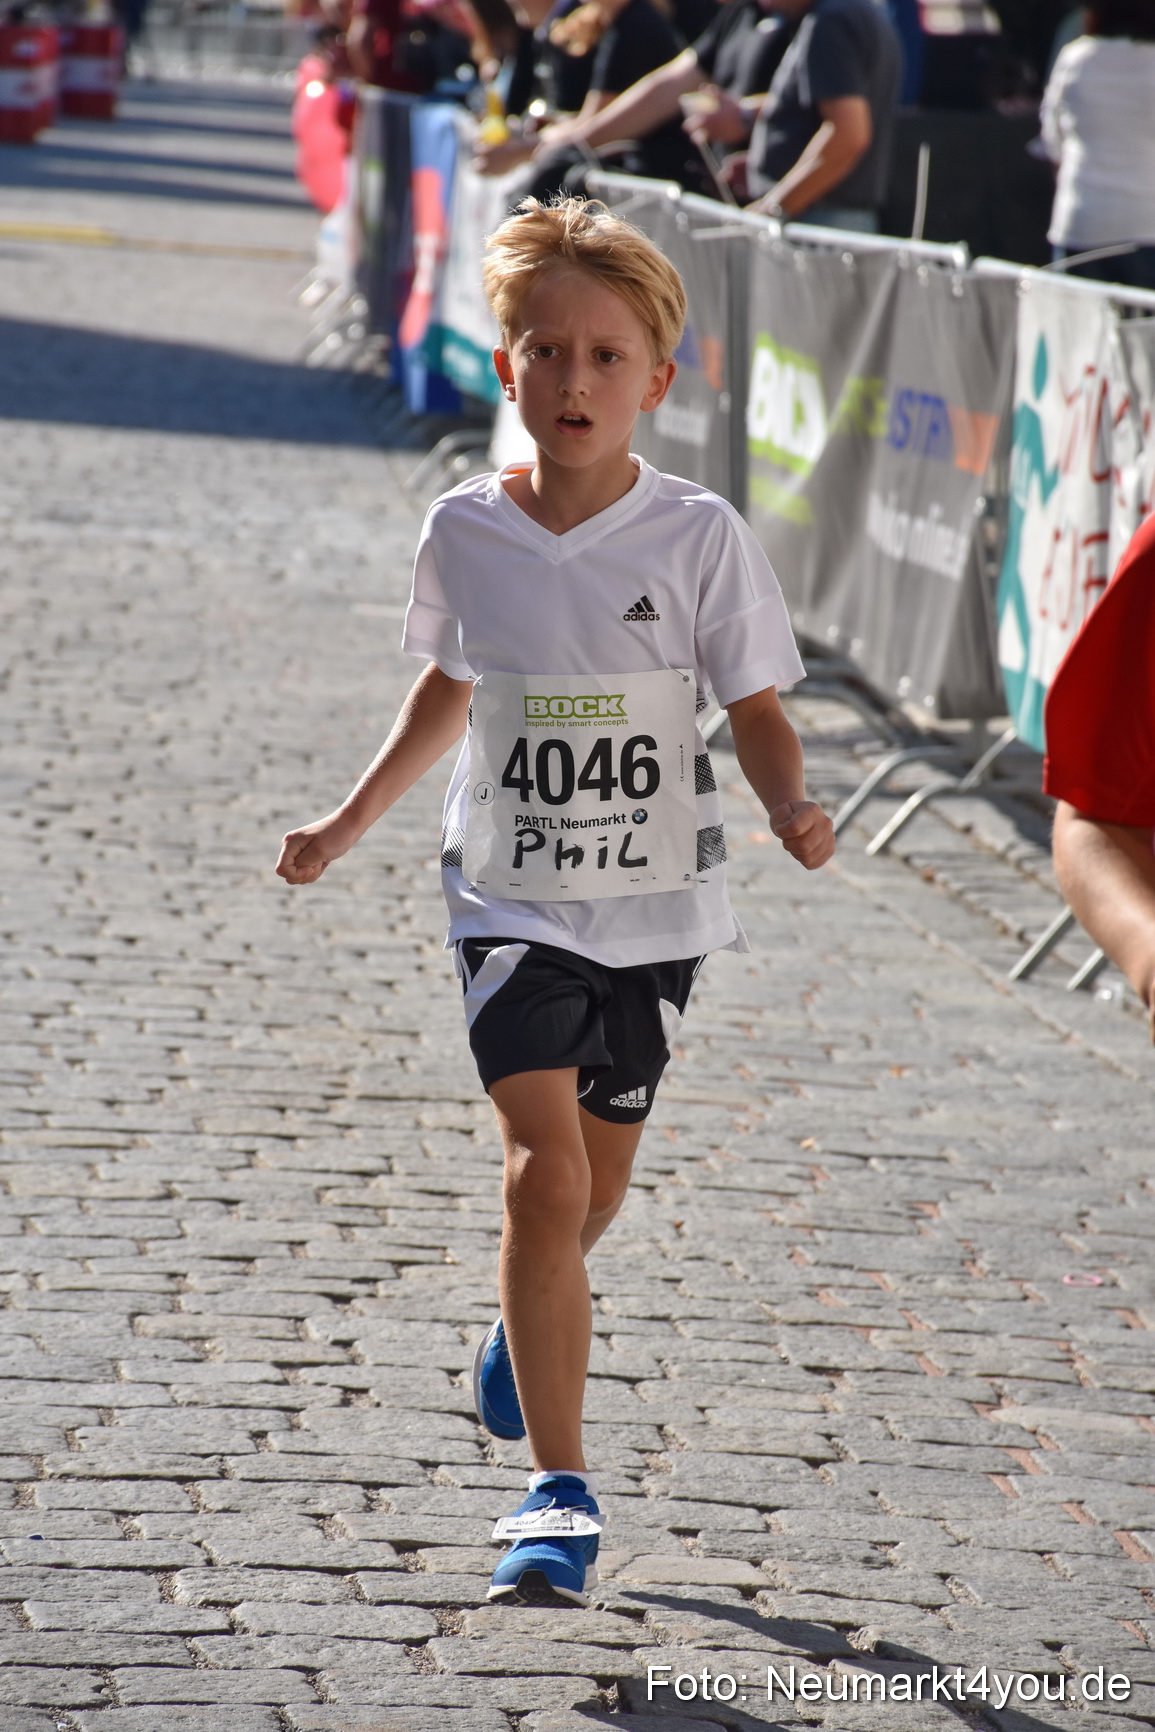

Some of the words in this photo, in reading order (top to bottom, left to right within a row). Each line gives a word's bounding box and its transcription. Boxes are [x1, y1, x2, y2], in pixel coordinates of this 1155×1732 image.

[623, 612, 660, 621] adidas
[524, 694, 628, 718] BOCK
[525, 719, 555, 729] inspired
[556, 719, 566, 728] by
[568, 719, 592, 727] smart
[593, 718, 629, 727] concepts
[501, 734, 661, 806] 4046
[480, 787, 488, 800] J
[514, 814, 558, 830] PARTL
[560, 813, 627, 830] Neumarkt
[609, 1097, 648, 1109] adidas
